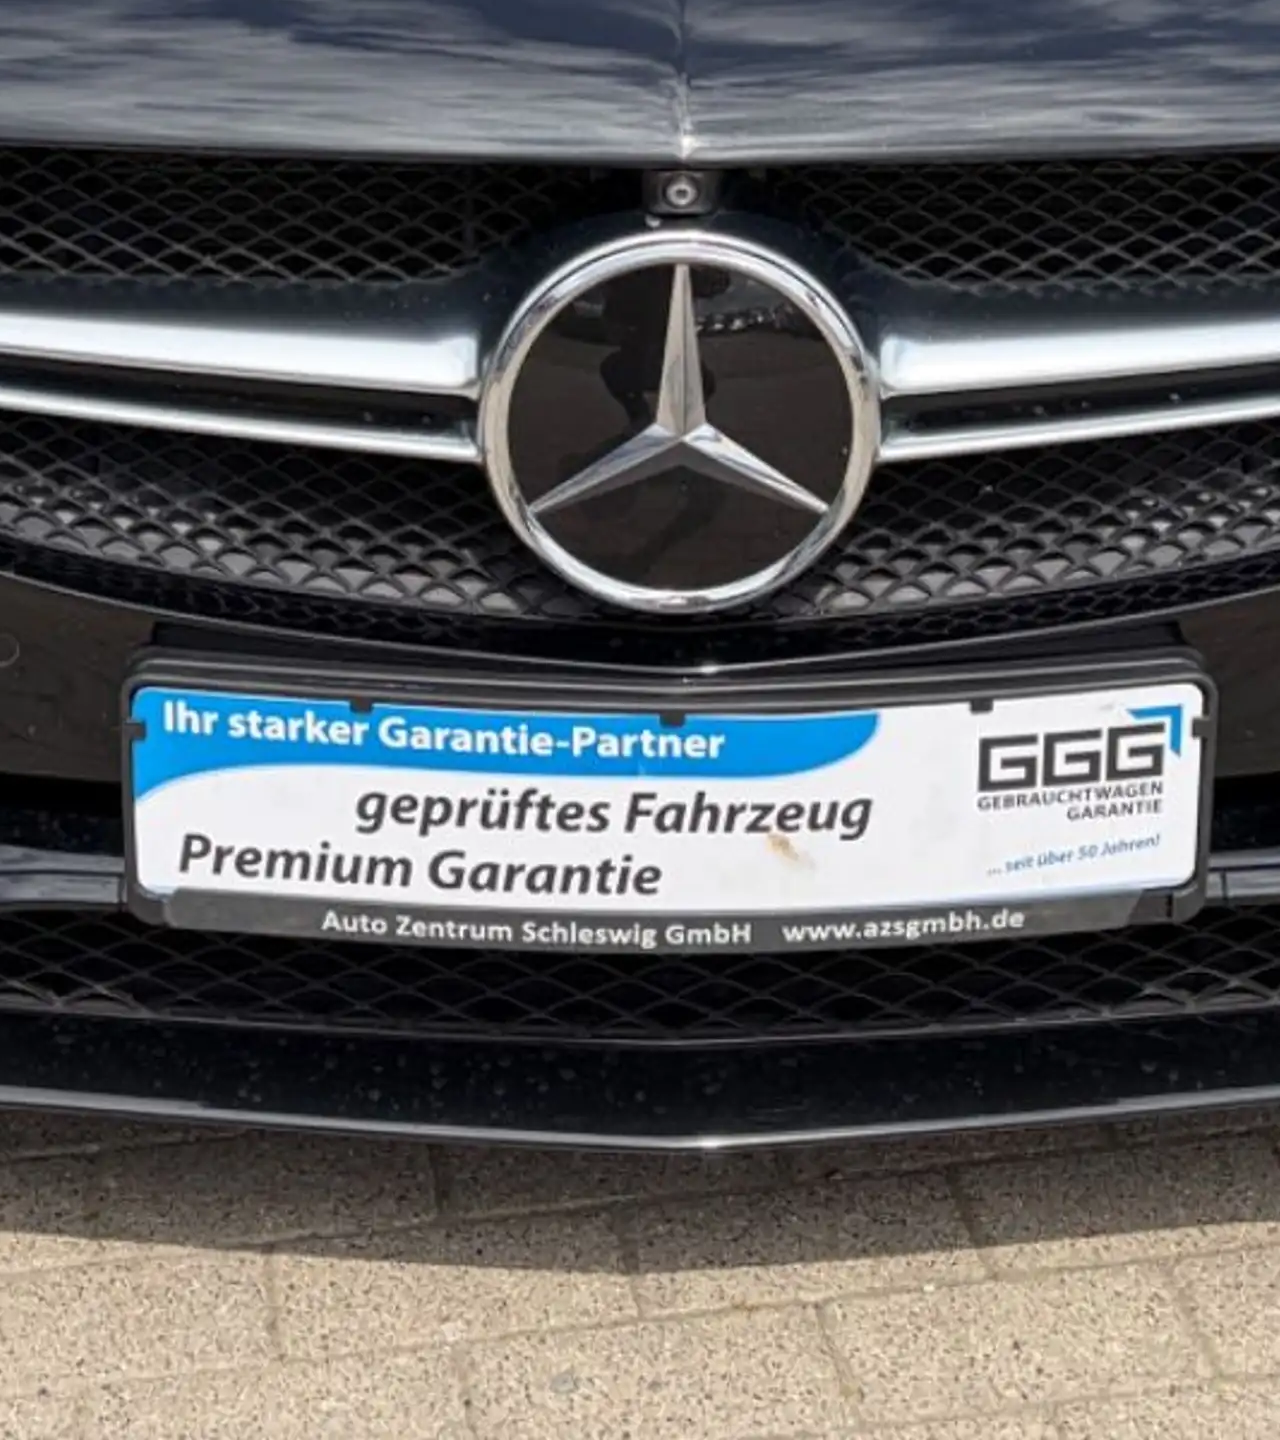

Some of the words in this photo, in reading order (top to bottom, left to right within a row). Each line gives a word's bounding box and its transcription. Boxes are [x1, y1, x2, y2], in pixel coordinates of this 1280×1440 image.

[163, 699, 218, 736] Ihr
[227, 710, 370, 745] starker
[377, 715, 726, 759] Garantie-Partner
[977, 722, 1166, 792] GGG
[354, 786, 611, 838] geprüftes
[624, 790, 874, 842] Fahrzeug
[976, 780, 1164, 813] GEBRAUCHTWAGEN
[1066, 798, 1163, 822] GARANTIE
[178, 833, 413, 888] Premium
[428, 849, 663, 896] Garantie
[320, 909, 389, 937] Auto
[394, 914, 514, 943] Zentrum
[521, 921, 658, 949] Schleswig
[665, 922, 752, 946] GmbH
[781, 908, 1026, 943] www.azsgmbh.de
